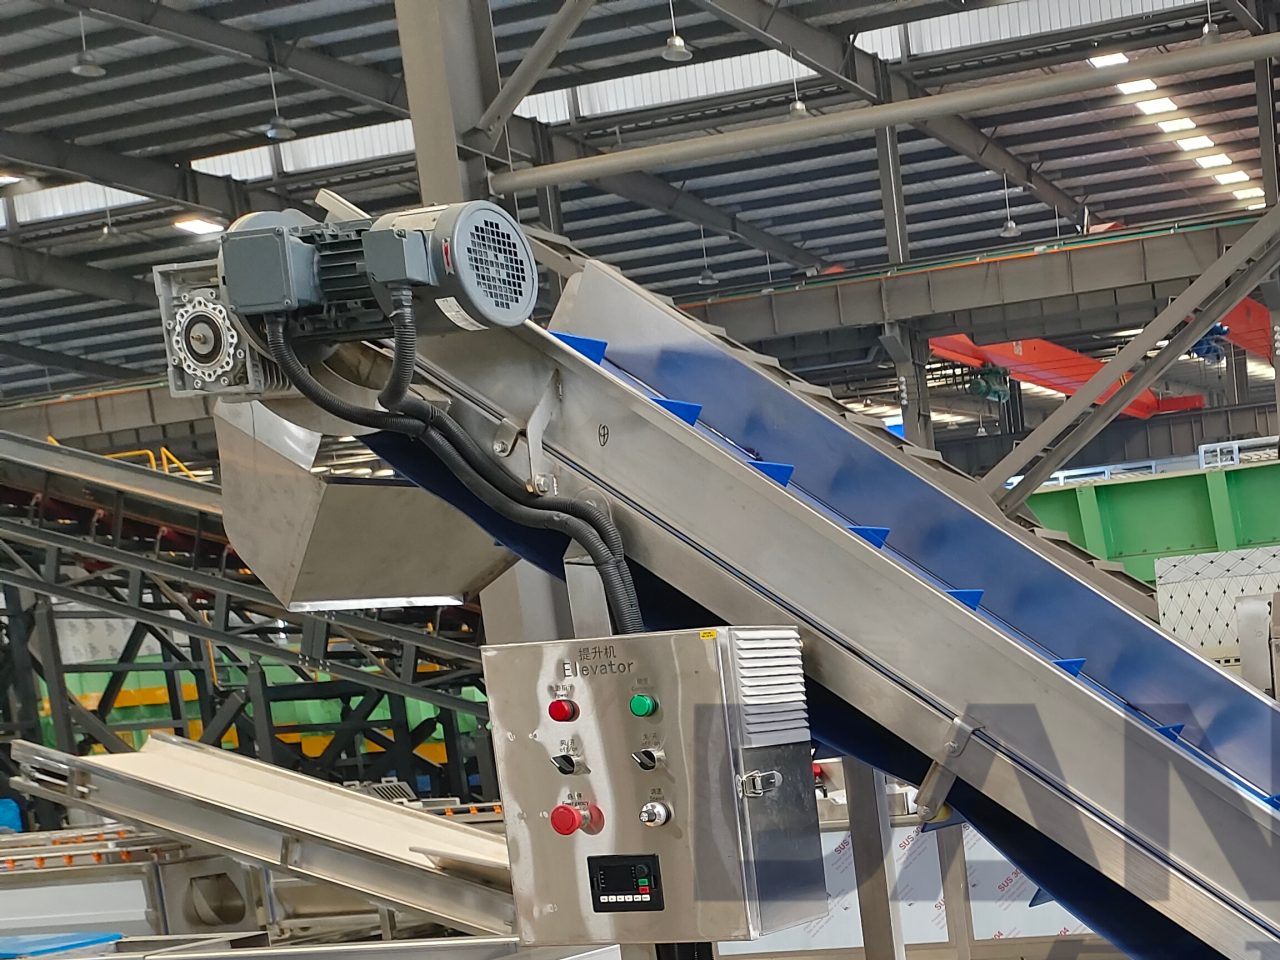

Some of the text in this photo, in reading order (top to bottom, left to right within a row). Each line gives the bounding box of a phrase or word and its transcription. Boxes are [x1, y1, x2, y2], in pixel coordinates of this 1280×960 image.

[579, 646, 616, 661] 提升机
[563, 661, 633, 678] Elevator
[835, 839, 850, 855] SUS
[899, 835, 915, 850] SUS
[997, 876, 1014, 893] SUS
